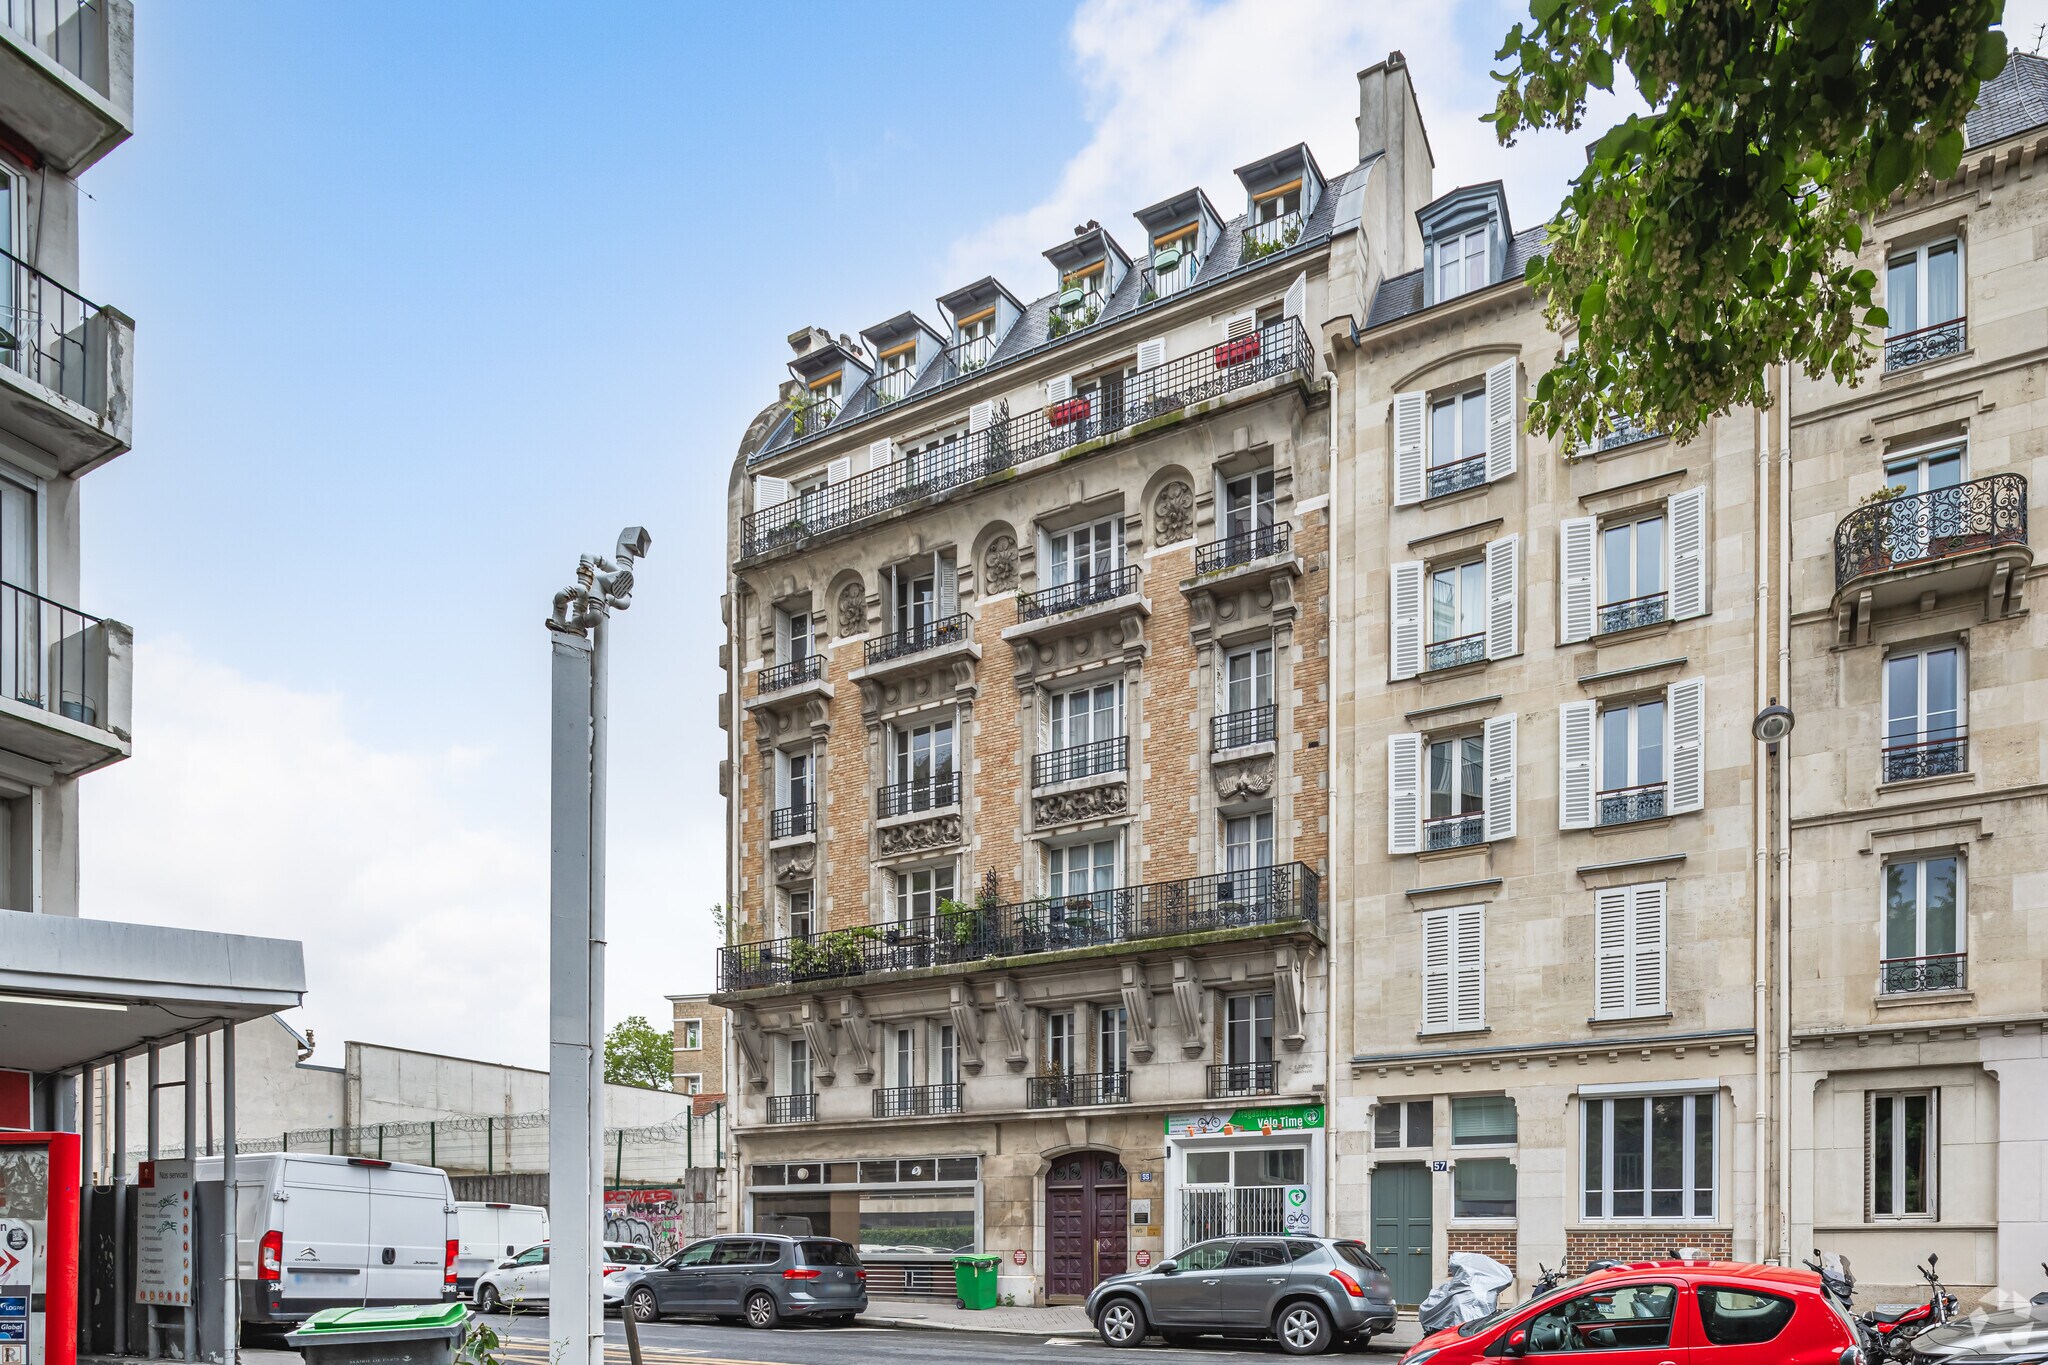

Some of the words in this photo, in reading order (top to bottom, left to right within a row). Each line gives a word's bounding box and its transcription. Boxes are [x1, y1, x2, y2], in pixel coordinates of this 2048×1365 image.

[1238, 1110, 1267, 1119] Magasin
[1257, 1116, 1278, 1128] Vélo
[1280, 1116, 1303, 1127] Time
[1434, 1161, 1446, 1171] 57
[160, 1171, 169, 1179] Nos
[169, 1171, 188, 1179] services
